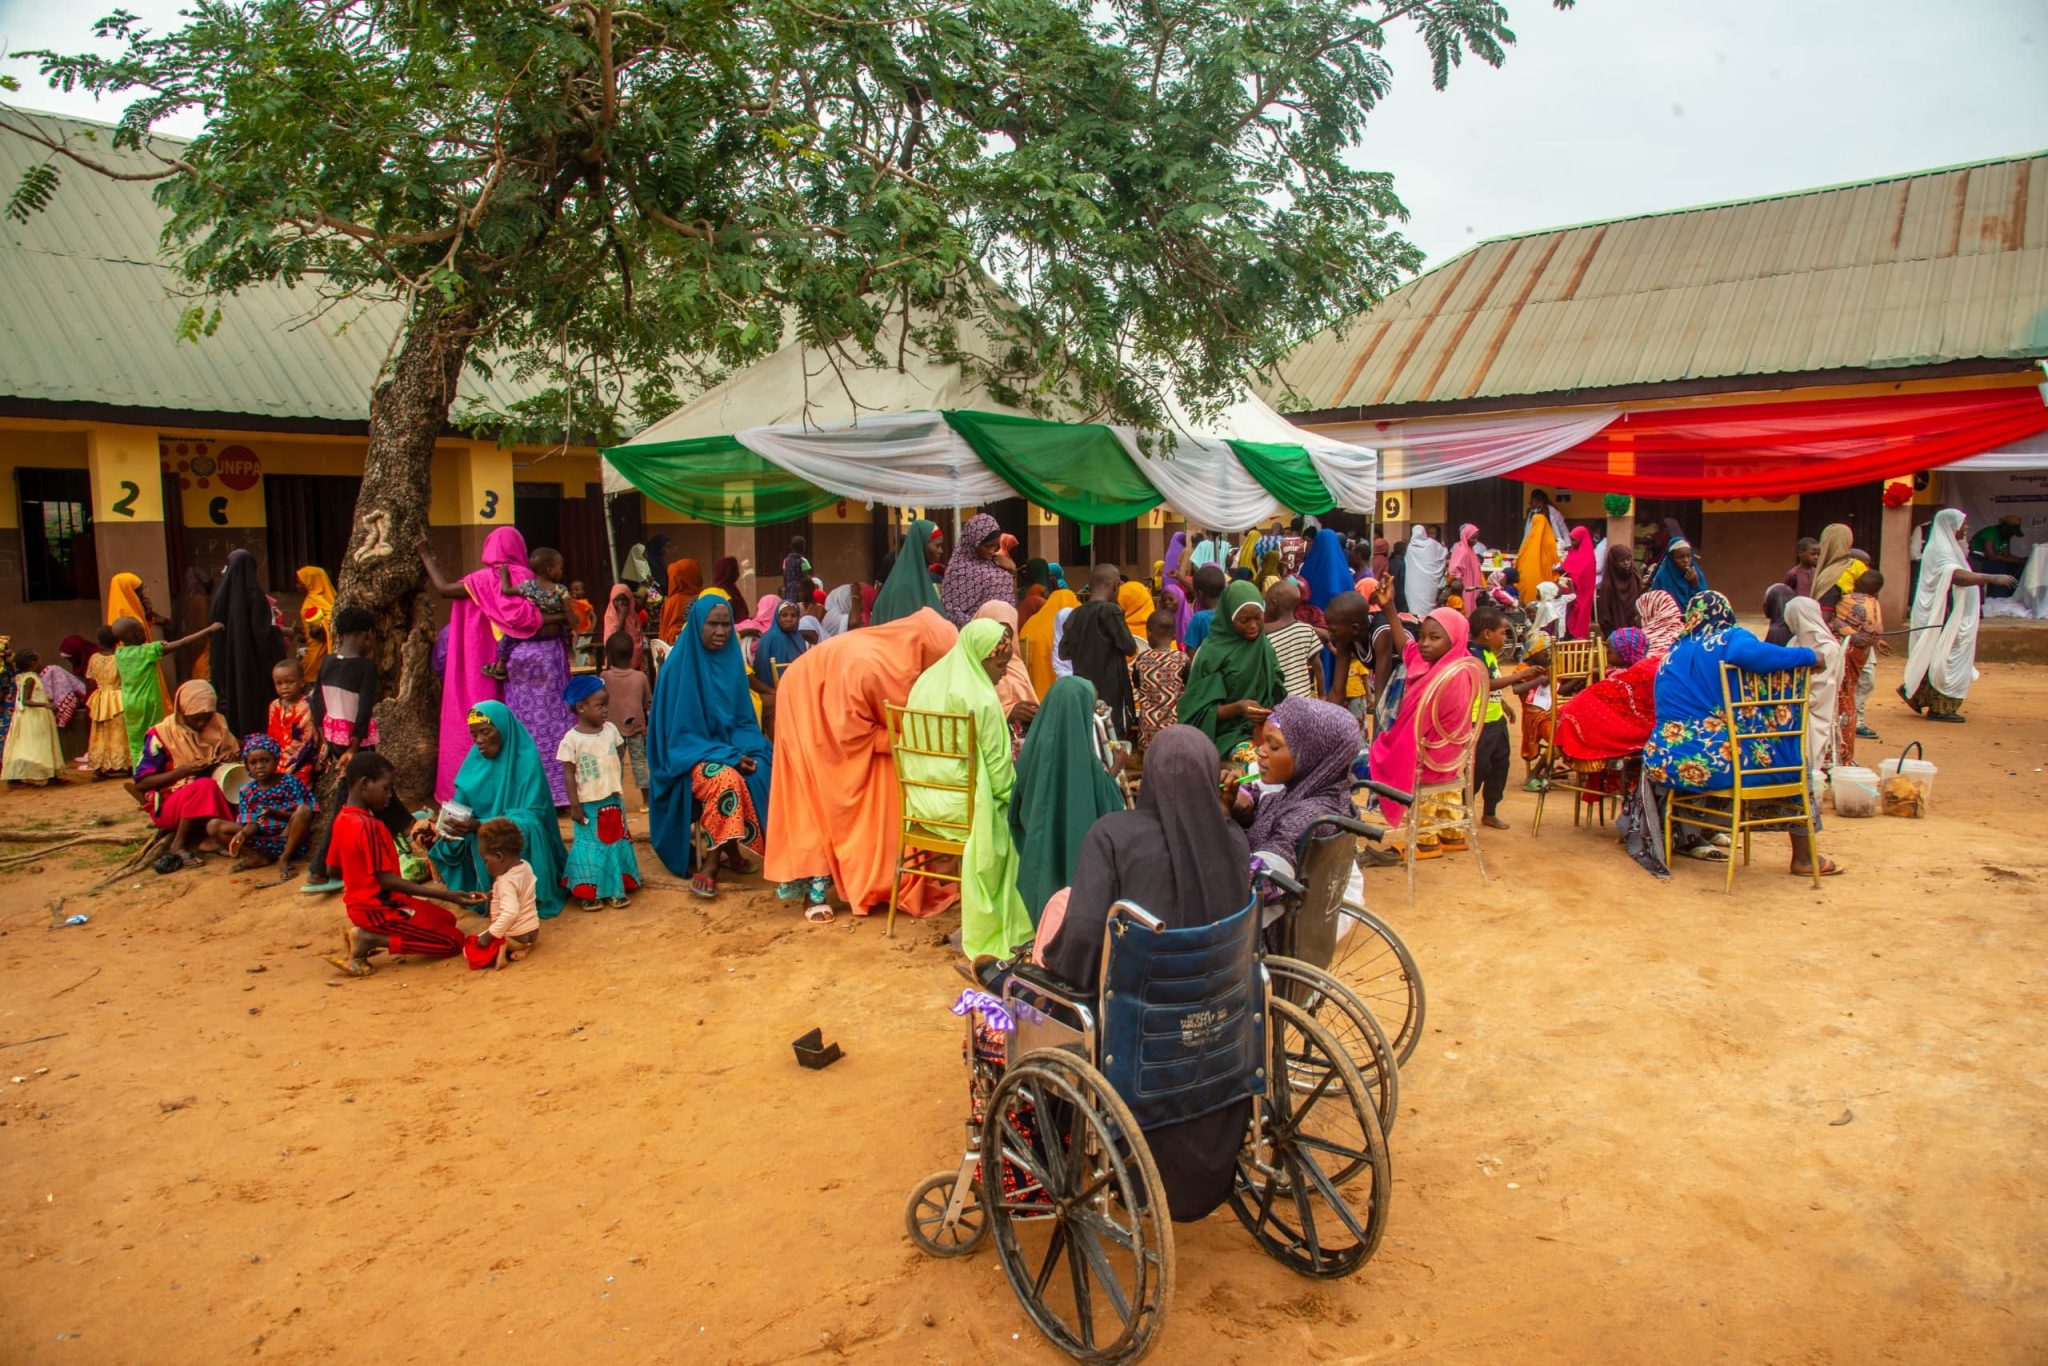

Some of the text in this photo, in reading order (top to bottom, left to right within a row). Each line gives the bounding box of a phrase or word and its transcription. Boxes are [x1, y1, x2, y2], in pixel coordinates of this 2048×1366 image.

[217, 461, 261, 475] UNFPA
[112, 481, 140, 518] 2
[209, 496, 229, 525] C
[480, 490, 499, 519] 3
[1385, 497, 1400, 519] 9
[1288, 553, 1295, 570] 3
